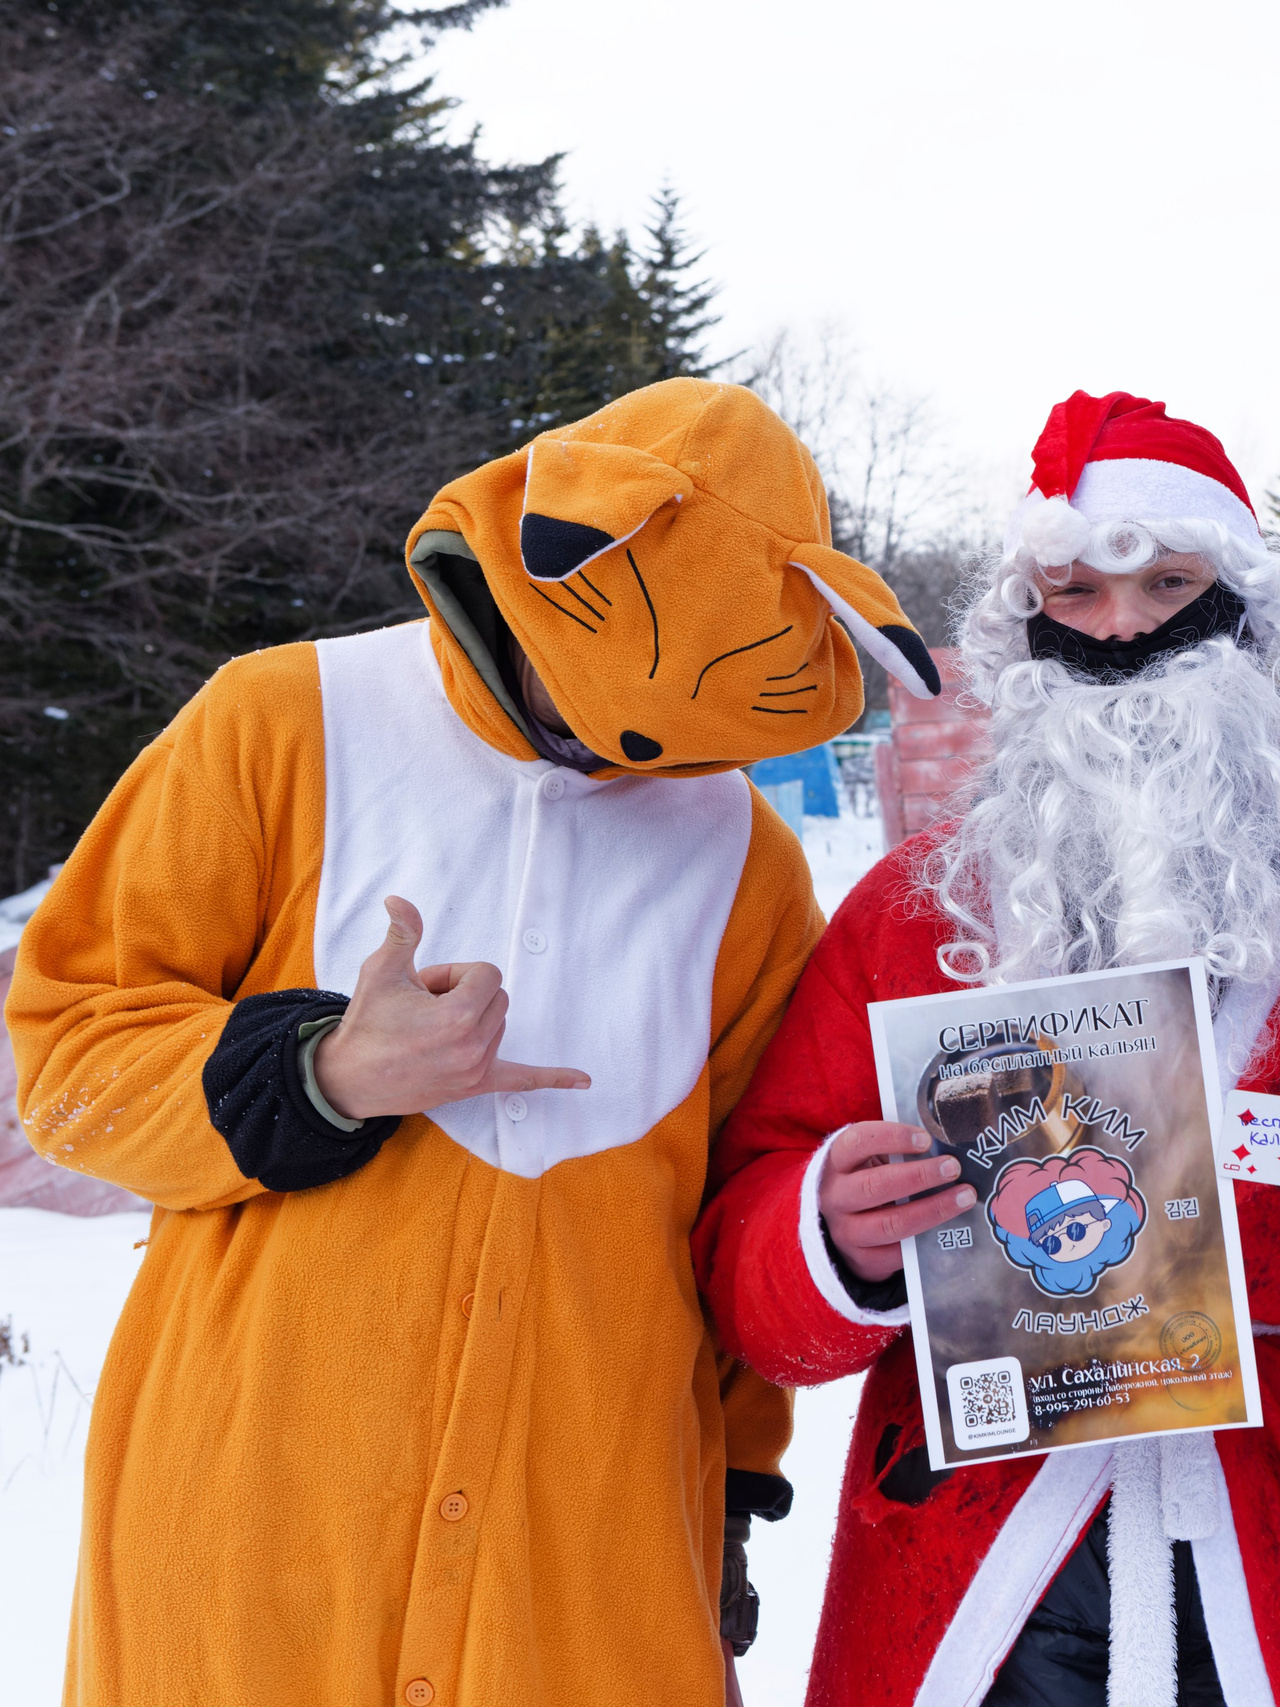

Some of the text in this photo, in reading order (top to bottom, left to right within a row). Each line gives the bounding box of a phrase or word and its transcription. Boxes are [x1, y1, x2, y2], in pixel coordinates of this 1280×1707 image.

[938, 1000, 1149, 1052] СЕРТИФИКАТ
[940, 1037, 1156, 1079] на бесплатный кальян
[968, 1095, 1147, 1168] КИМ КИМ
[1166, 1200, 1199, 1218] 김김
[939, 1228, 972, 1248] 김김
[1013, 1296, 1148, 1333] ЛАУНДЖ
[1030, 1374, 1057, 1393] ул.
[1190, 1353, 1202, 1369] 2
[1032, 1393, 1055, 1403] (вход
[1057, 1391, 1067, 1399] со
[1068, 1386, 1103, 1398] стороны
[1160, 1373, 1207, 1386] цокольный
[1209, 1370, 1233, 1380] этаж)
[1034, 1392, 1131, 1416] 8-995-291-60-53
[967, 1427, 1017, 1440] @KIMKIMLOUNGE
